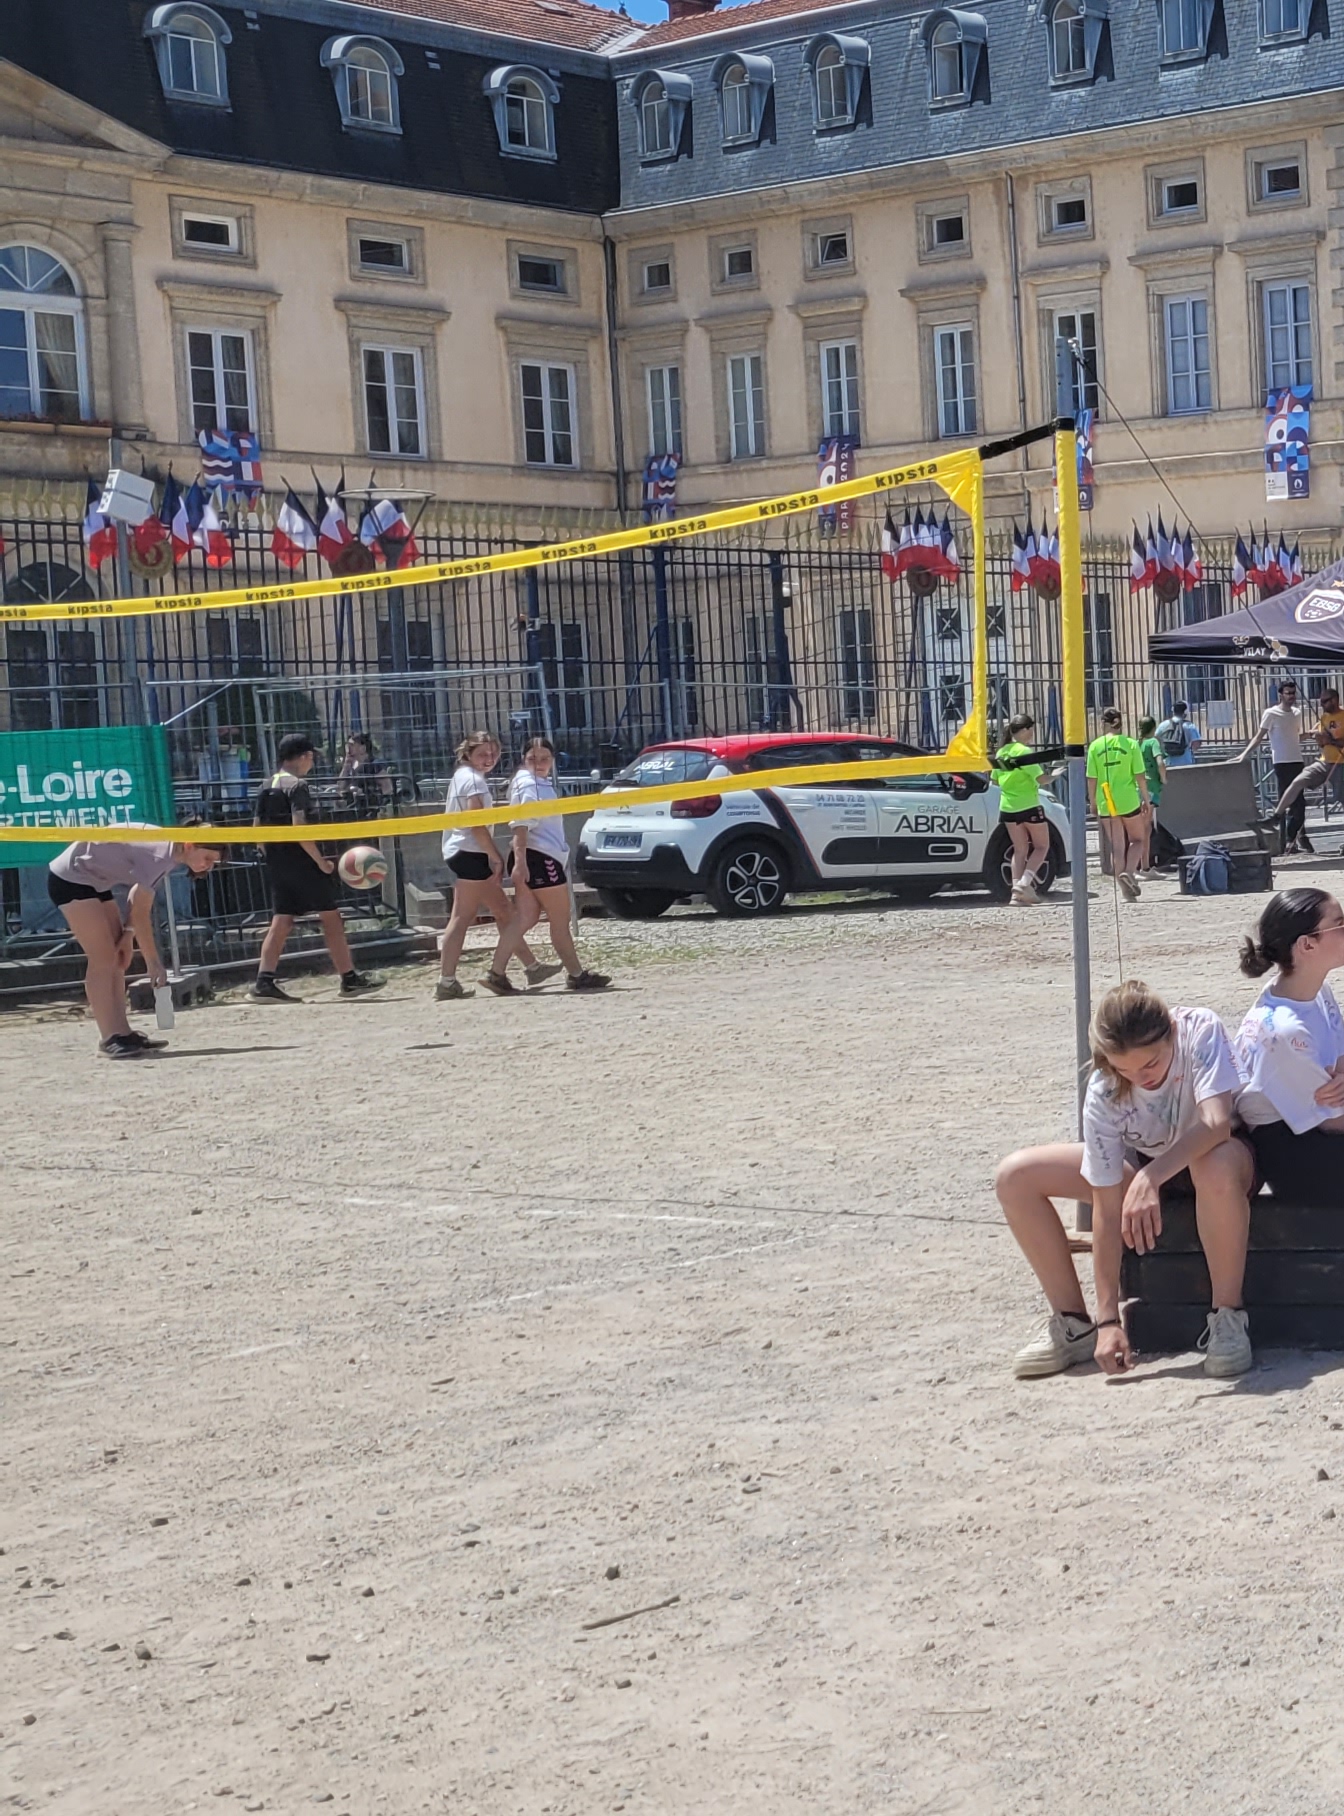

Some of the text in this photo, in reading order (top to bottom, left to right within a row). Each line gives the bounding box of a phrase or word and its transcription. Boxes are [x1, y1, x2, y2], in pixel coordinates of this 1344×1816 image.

[875, 463, 938, 488] kipsta
[758, 493, 819, 516] kipsta
[649, 519, 707, 540] kipsta
[541, 541, 597, 560] kipsta
[438, 561, 491, 578] kipsta
[340, 575, 392, 592] kipsta
[155, 596, 202, 609] kipsta
[245, 587, 295, 602] kipsta
[67, 603, 113, 616] kipsta
[1309, 597, 1341, 612] EBSG
[917, 805, 960, 814] GARAGE
[894, 815, 984, 834] ABRIAL
